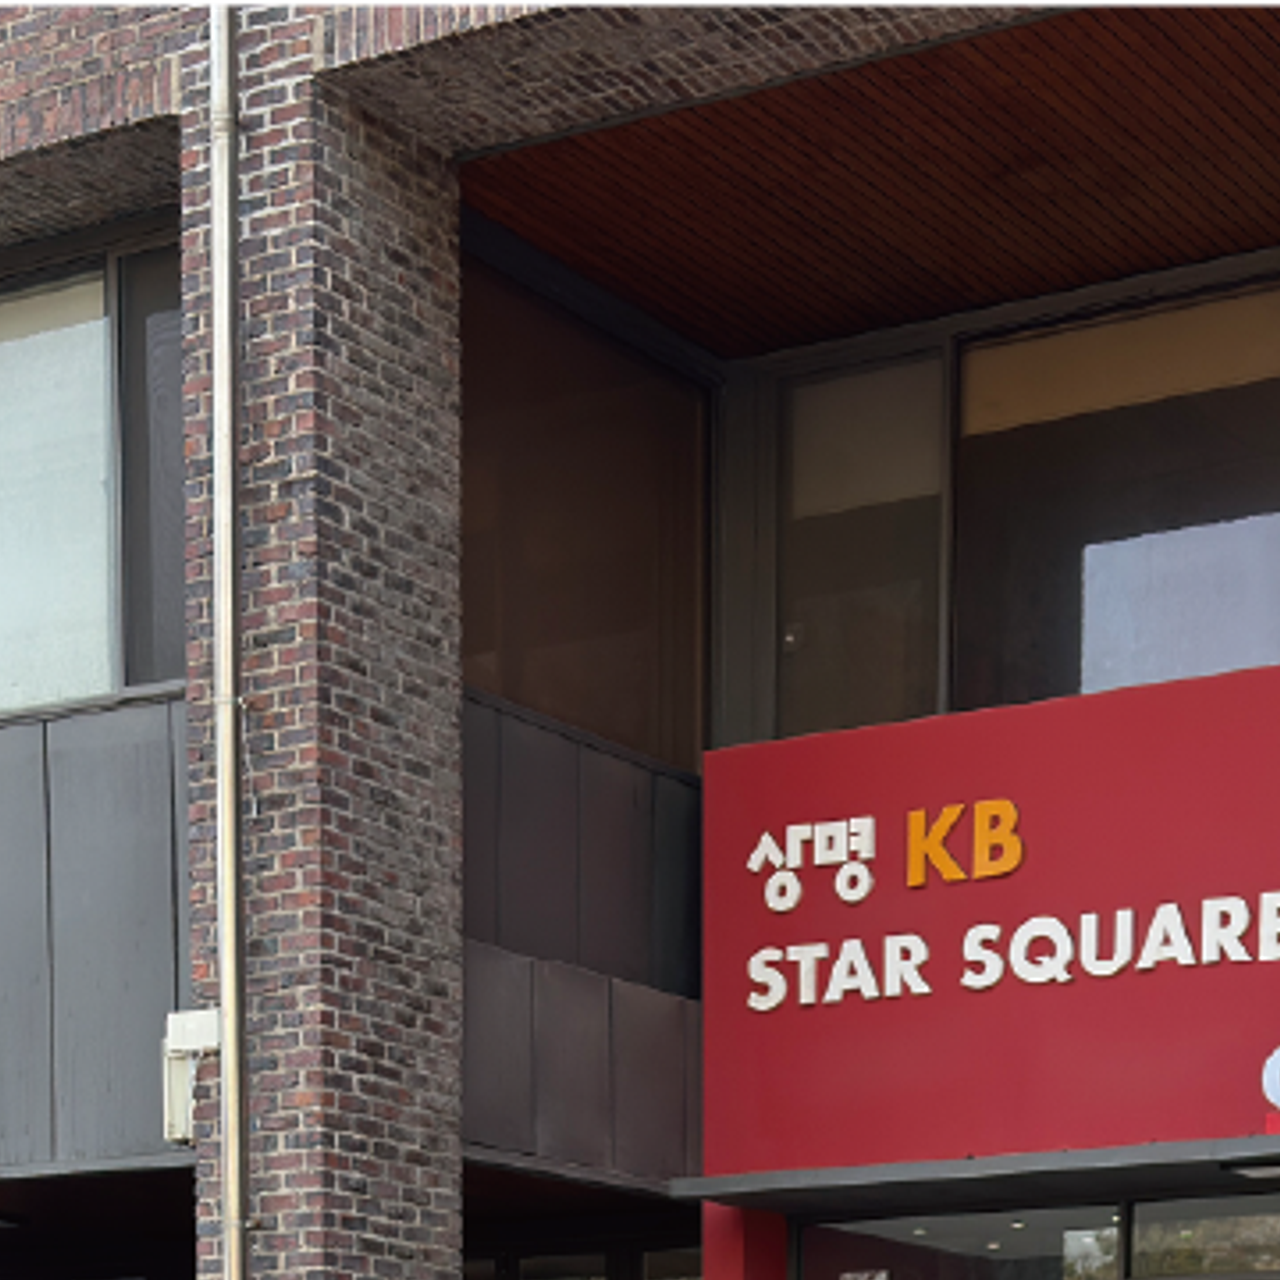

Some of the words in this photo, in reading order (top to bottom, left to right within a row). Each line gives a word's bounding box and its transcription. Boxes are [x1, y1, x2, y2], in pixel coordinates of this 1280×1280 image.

[746, 816, 875, 912] 상명
[906, 798, 1023, 888] KB
[746, 933, 932, 1012] STAR
